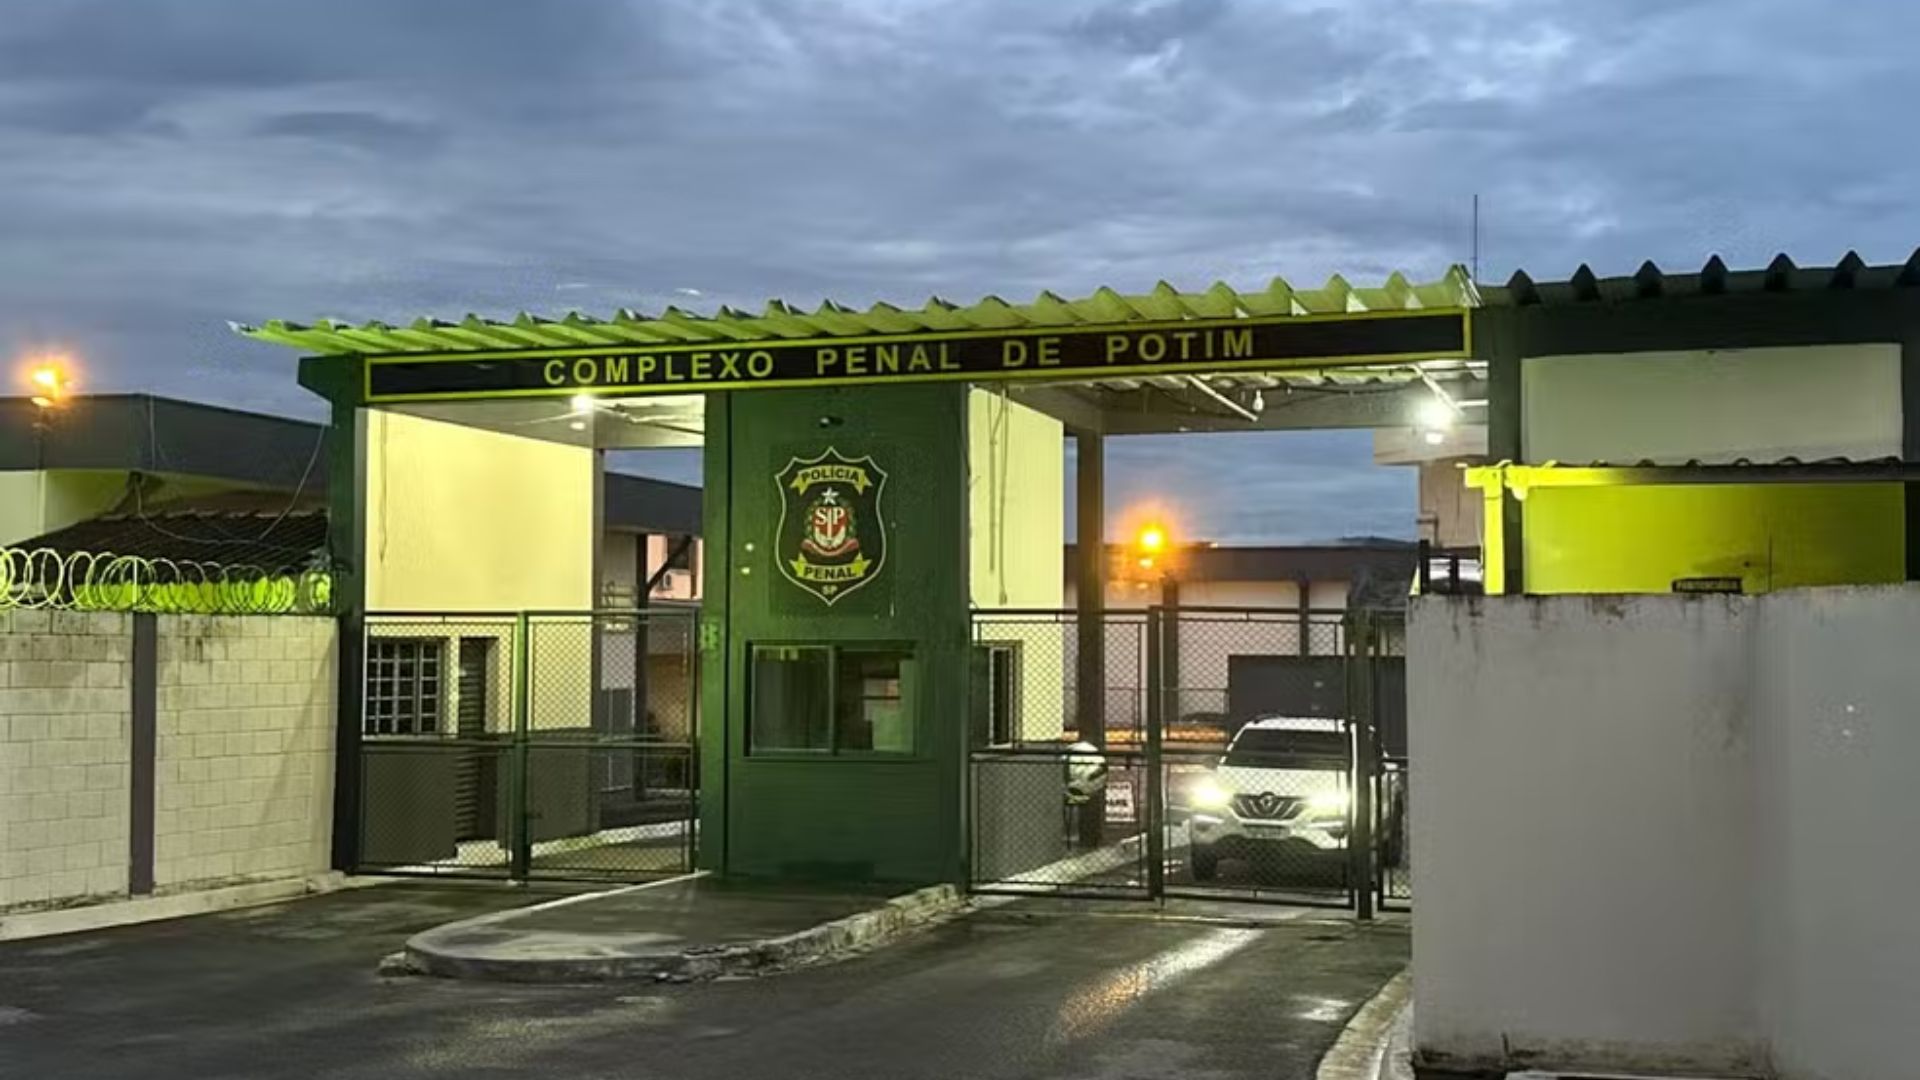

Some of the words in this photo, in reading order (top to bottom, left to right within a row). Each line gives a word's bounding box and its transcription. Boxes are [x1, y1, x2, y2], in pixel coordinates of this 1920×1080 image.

[544, 351, 773, 385] COMPLEXO
[816, 342, 960, 375] PENAL
[1003, 338, 1061, 367] DE
[1106, 330, 1253, 363] POTIM
[803, 567, 857, 579] PENAL
